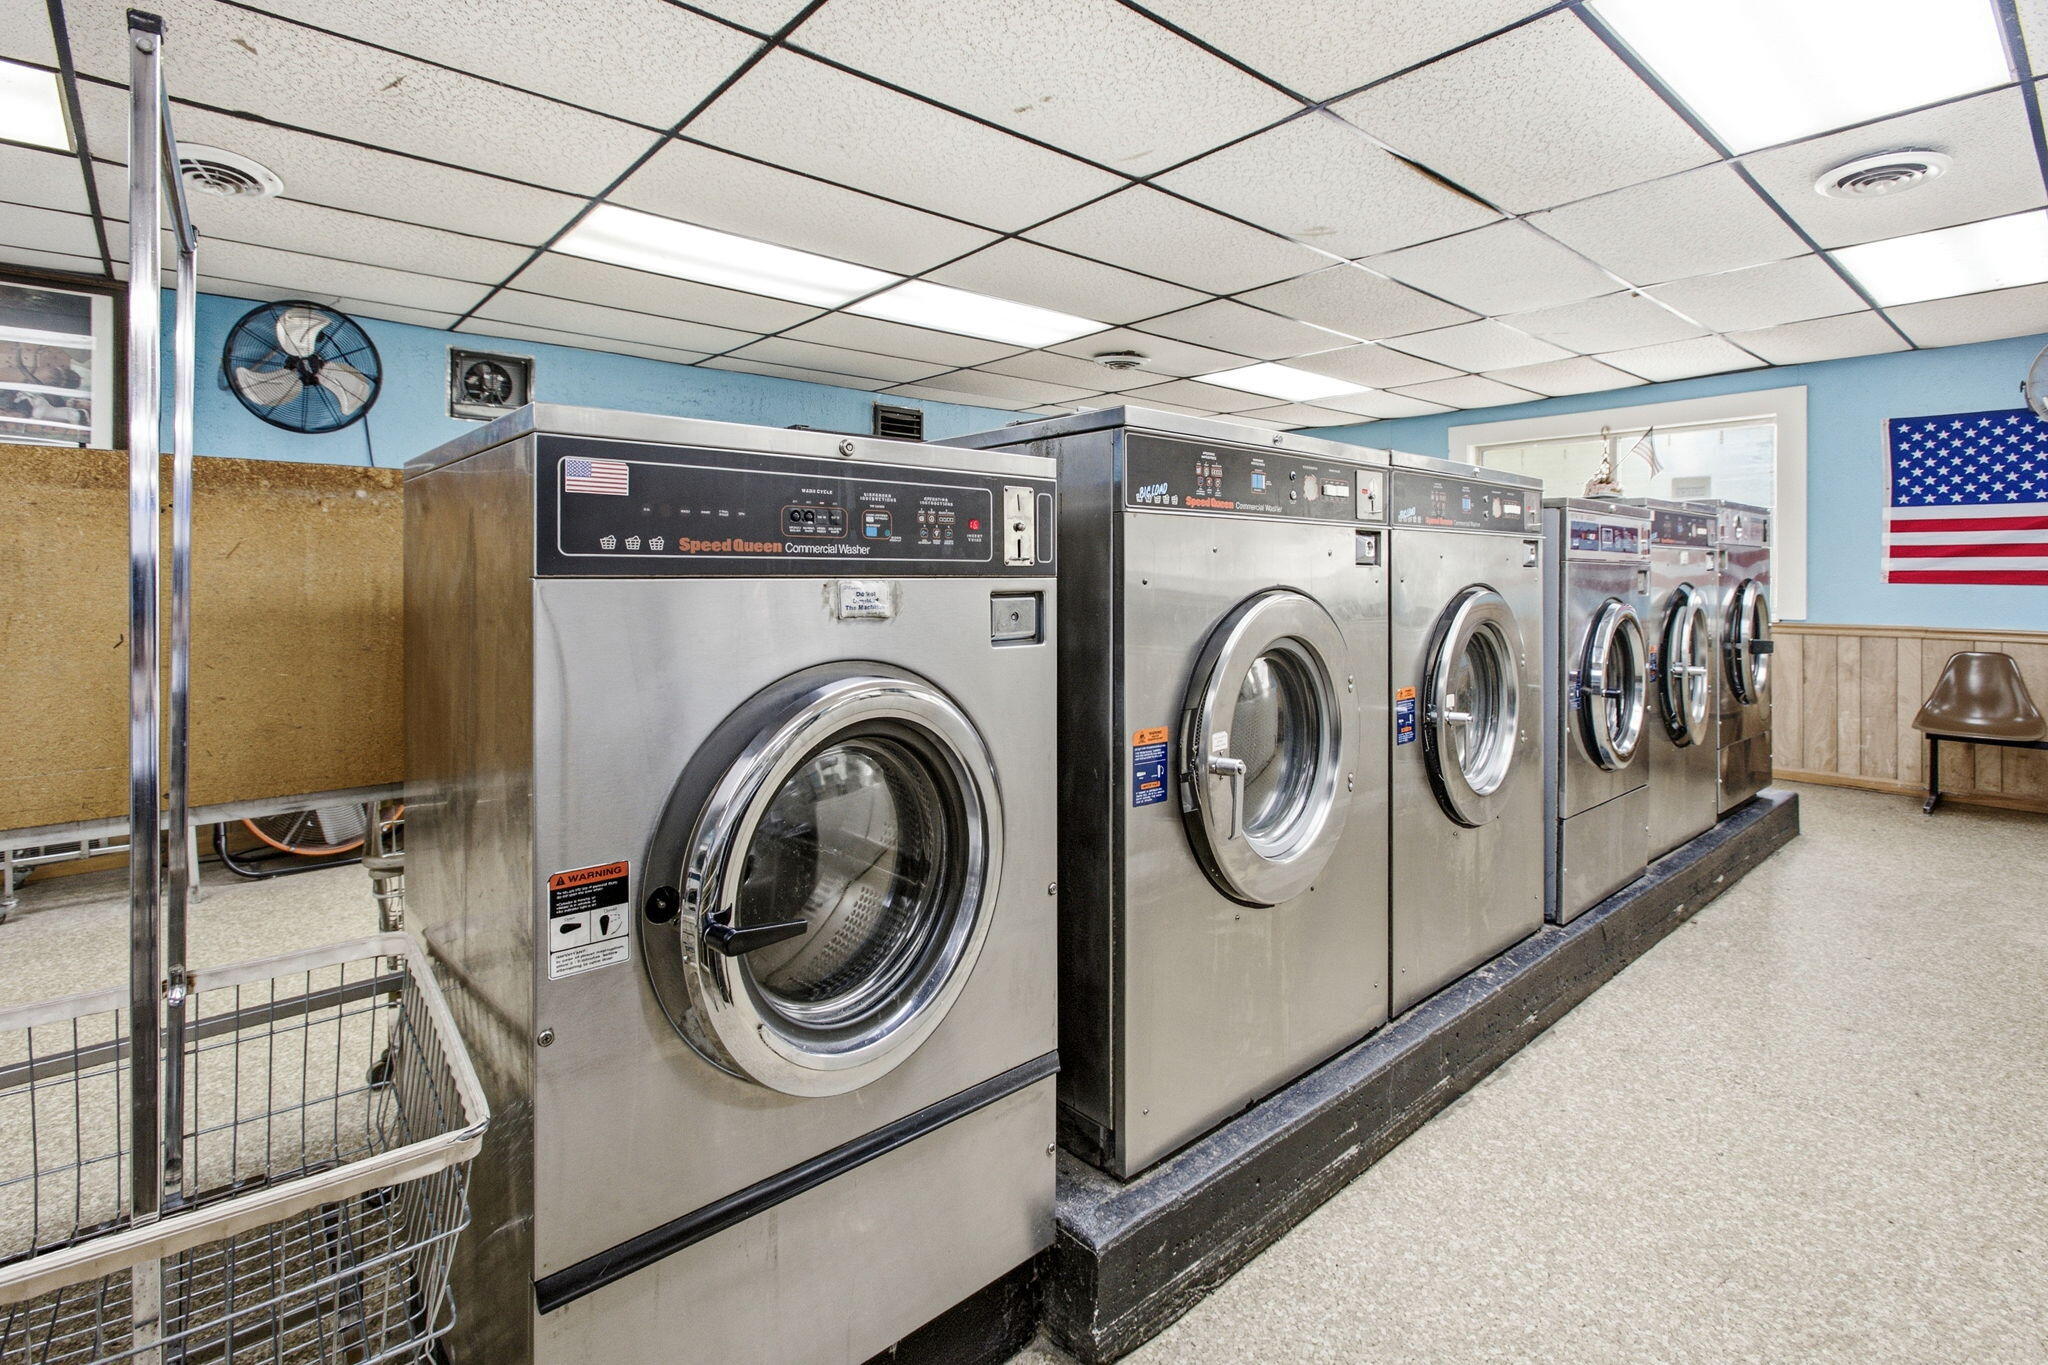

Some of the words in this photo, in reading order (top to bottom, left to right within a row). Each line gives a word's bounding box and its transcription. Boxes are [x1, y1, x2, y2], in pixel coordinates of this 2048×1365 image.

[678, 537, 732, 554] Speed
[733, 539, 782, 553] Queen
[785, 542, 837, 554] Commercial
[839, 544, 870, 554] Washer
[568, 866, 622, 882] WARNING
